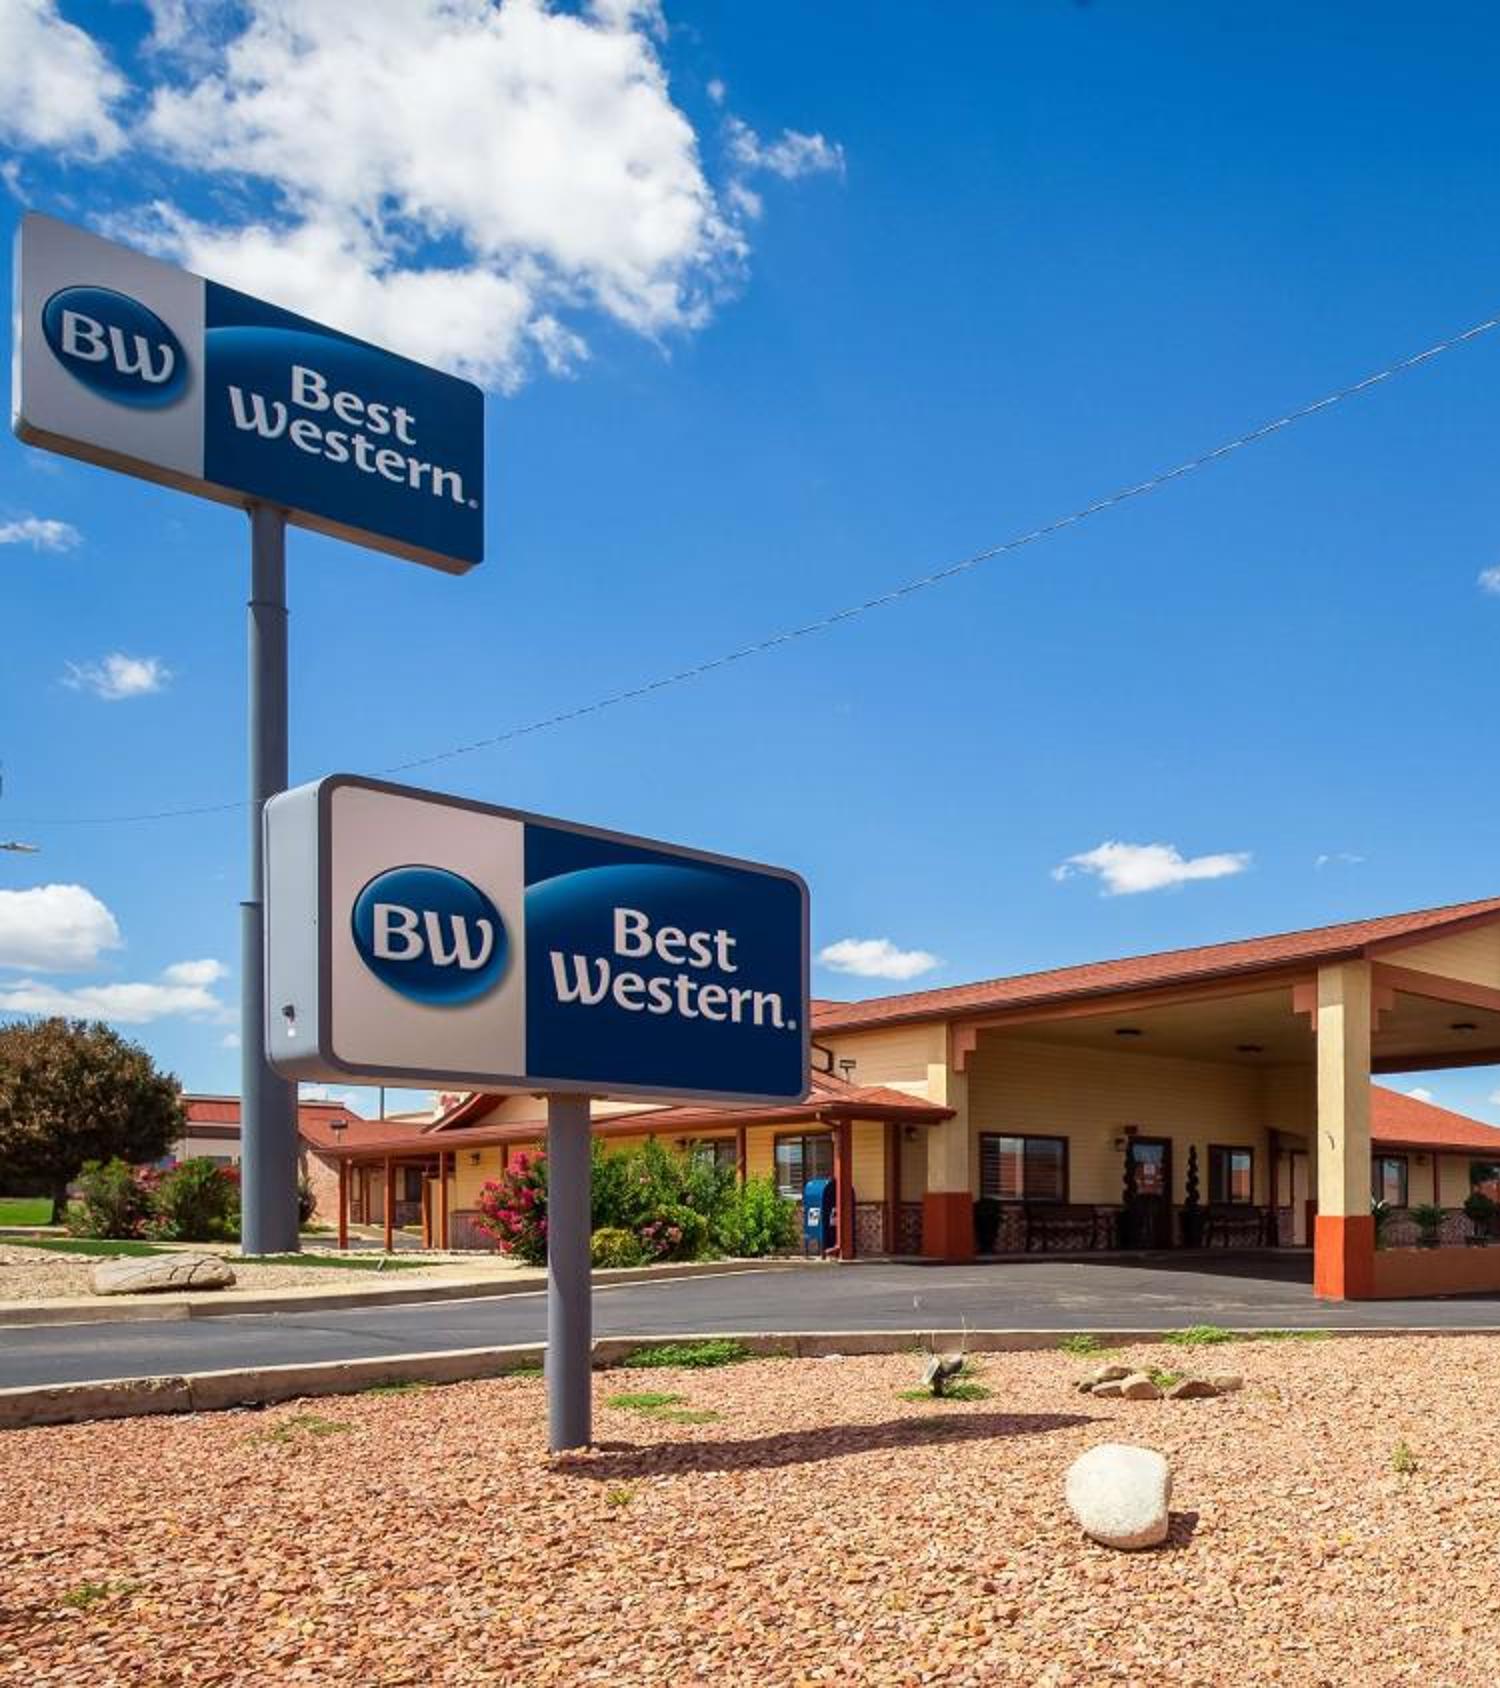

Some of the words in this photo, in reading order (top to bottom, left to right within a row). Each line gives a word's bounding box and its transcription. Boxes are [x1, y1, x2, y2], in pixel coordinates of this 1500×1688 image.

[61, 309, 174, 383] BW
[291, 364, 416, 445] Best
[372, 902, 494, 969] BW
[613, 907, 738, 973] Best
